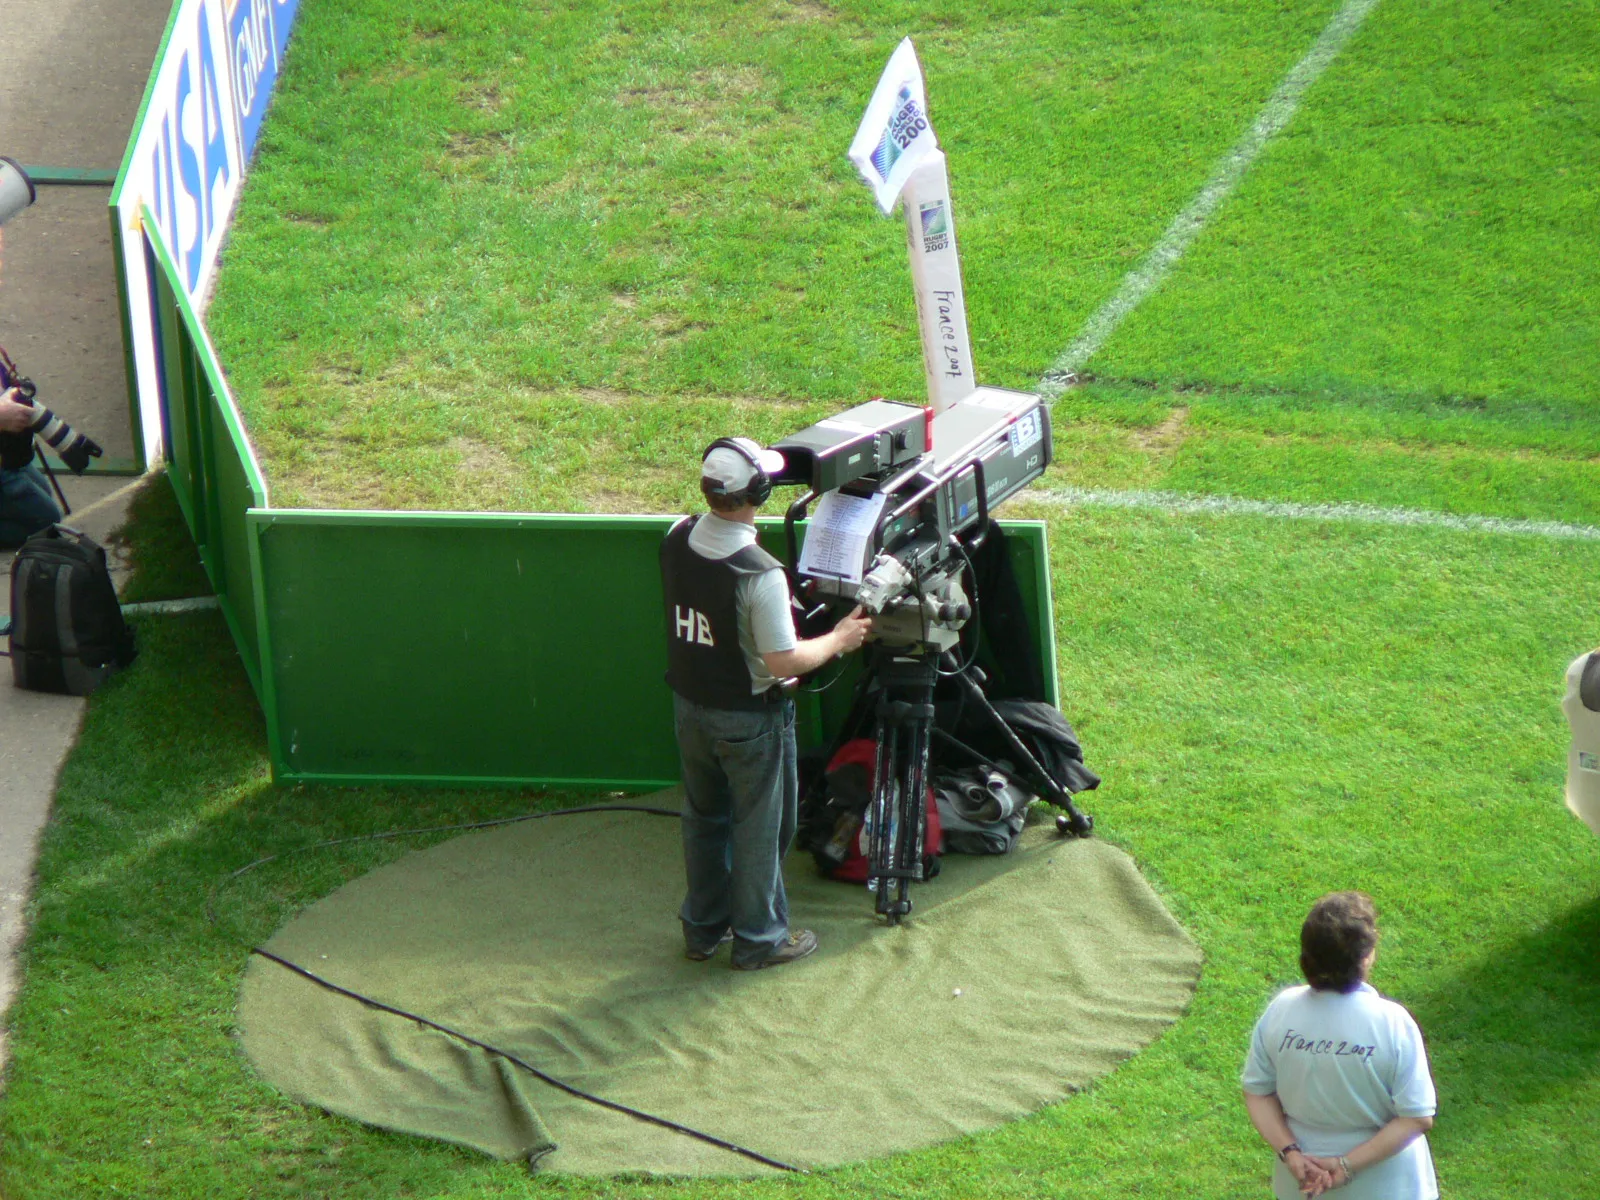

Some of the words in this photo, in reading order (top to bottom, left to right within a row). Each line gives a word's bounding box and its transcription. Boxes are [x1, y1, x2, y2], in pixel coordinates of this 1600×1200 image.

[898, 116, 927, 149] 200
[925, 241, 949, 253] 2007
[933, 291, 955, 340] France
[944, 345, 962, 379] 2007
[1026, 454, 1038, 470] HD
[676, 604, 714, 647] HB
[1279, 1029, 1333, 1055] France
[1335, 1041, 1376, 1063] 2007
